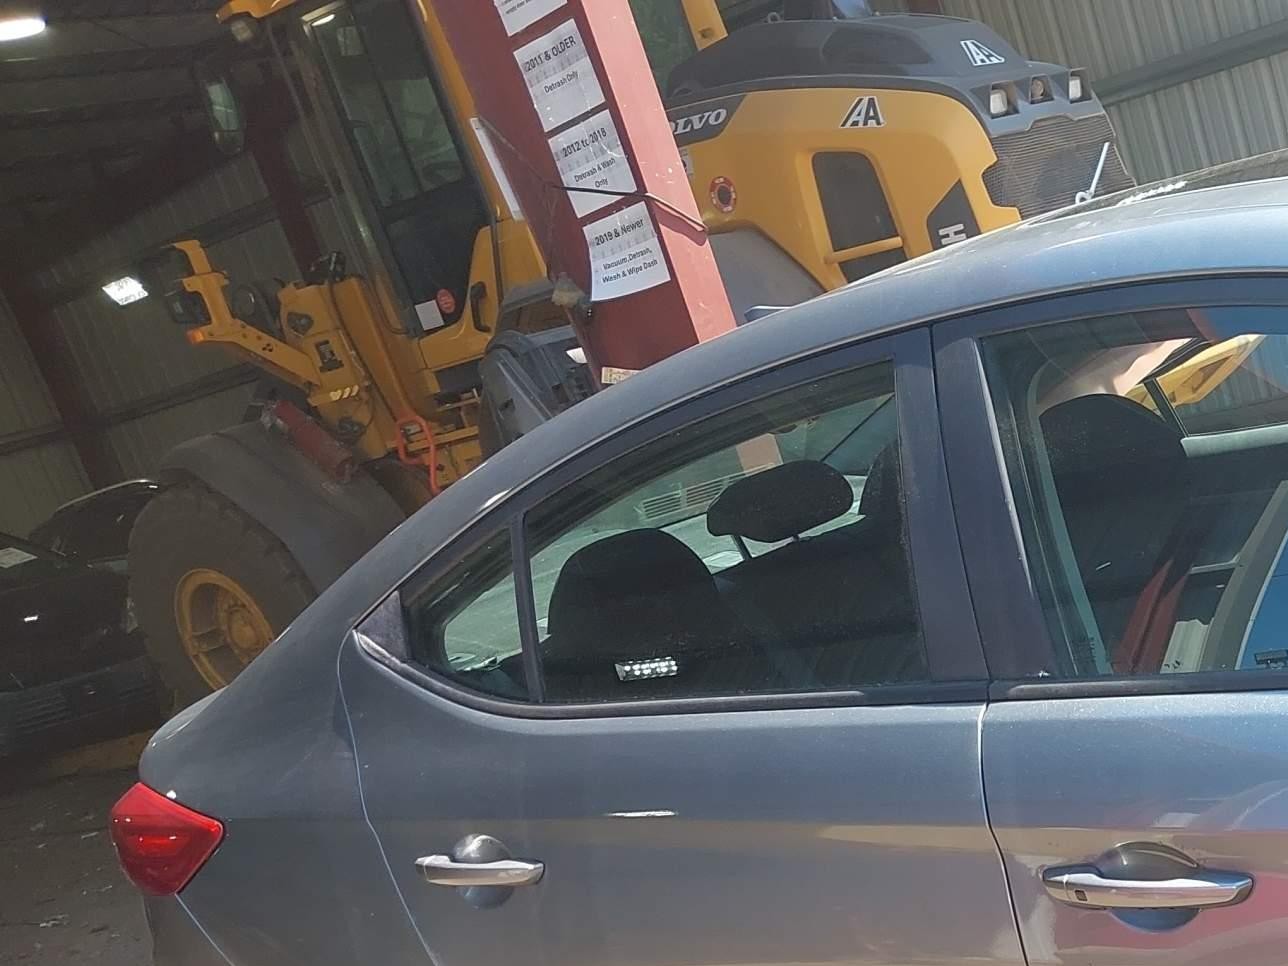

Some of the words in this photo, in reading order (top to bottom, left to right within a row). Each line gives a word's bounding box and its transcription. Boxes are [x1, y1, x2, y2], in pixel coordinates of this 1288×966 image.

[524, 52, 545, 72] 2011
[543, 50, 552, 61] &
[551, 35, 577, 57] OLDER
[543, 78, 568, 93] Detrash
[566, 71, 579, 82] Only
[562, 140, 582, 158] 2012
[594, 178, 609, 188] Only
[594, 231, 614, 246] 2019
[613, 228, 621, 238] &
[620, 219, 645, 236] Newer
[621, 270, 628, 278] &
[626, 265, 643, 275] Wipe
[643, 258, 658, 270] Dash
